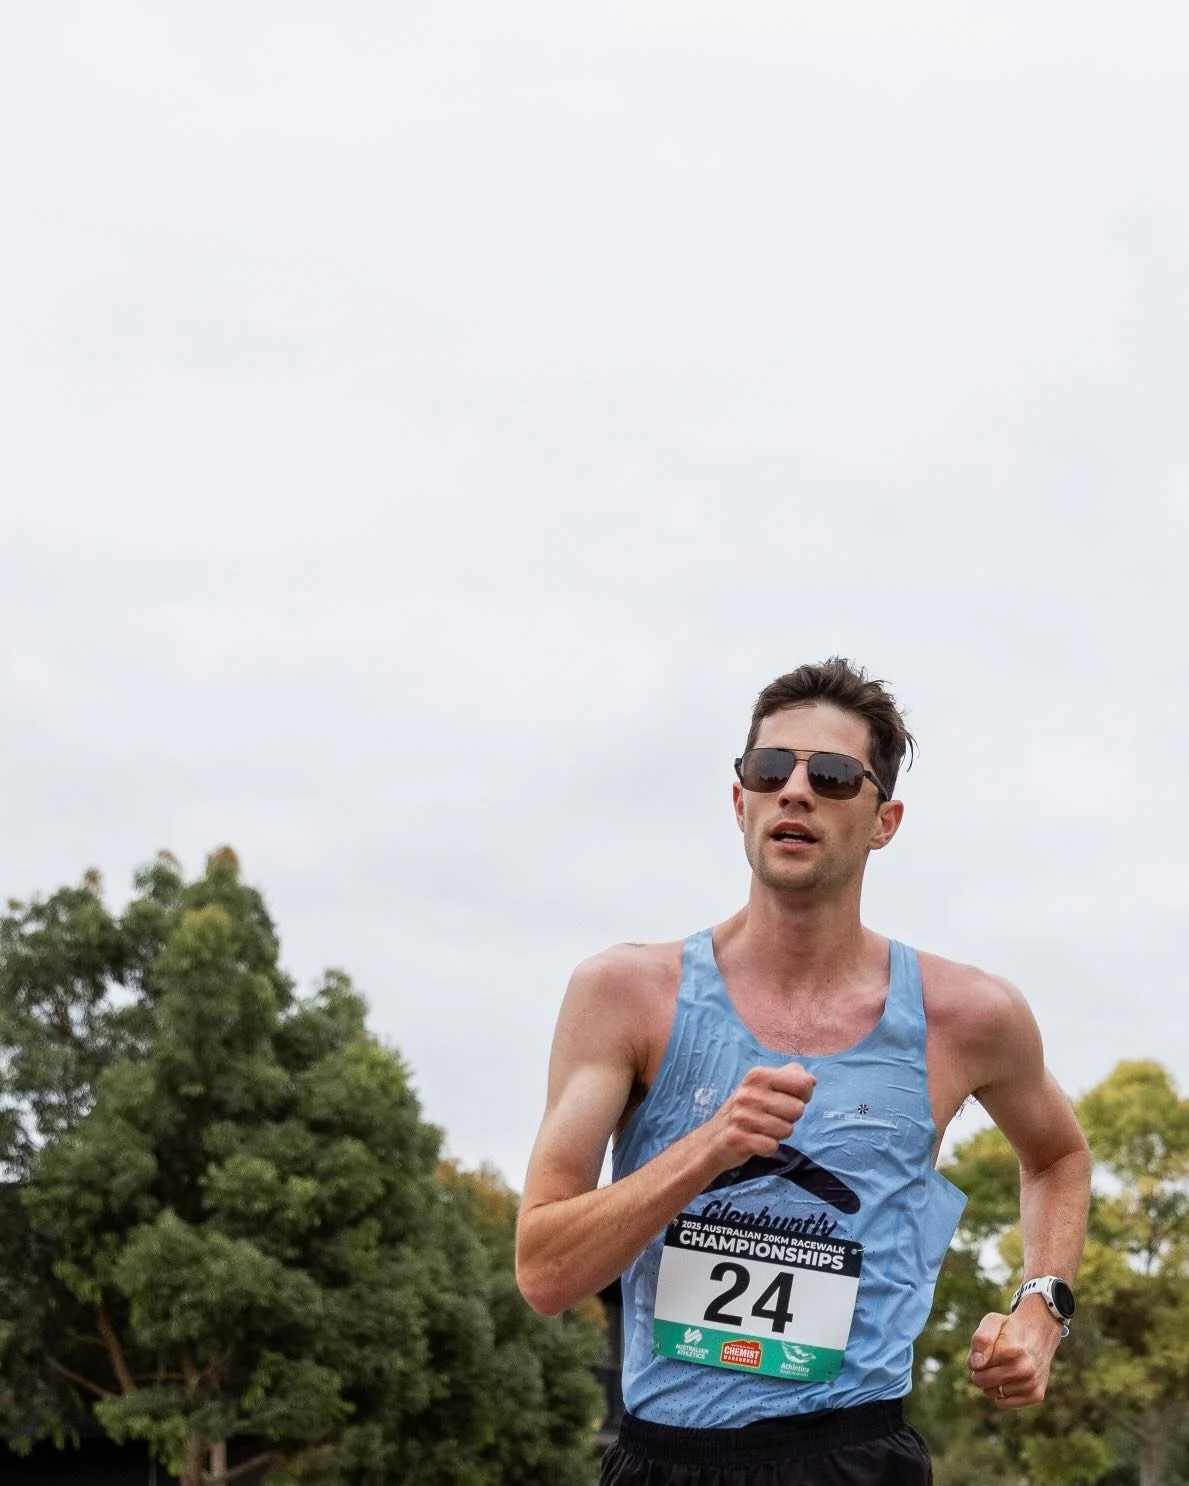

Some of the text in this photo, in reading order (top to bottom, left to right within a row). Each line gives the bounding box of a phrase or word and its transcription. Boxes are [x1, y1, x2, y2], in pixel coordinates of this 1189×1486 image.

[679, 1230, 844, 1270] CHAMPIONSHIPS
[681, 1220, 846, 1255] 2025 AUSTRALIAN 20KM RACEWALK
[703, 1261, 795, 1334] 24
[724, 1346, 760, 1360] CHEMIST
